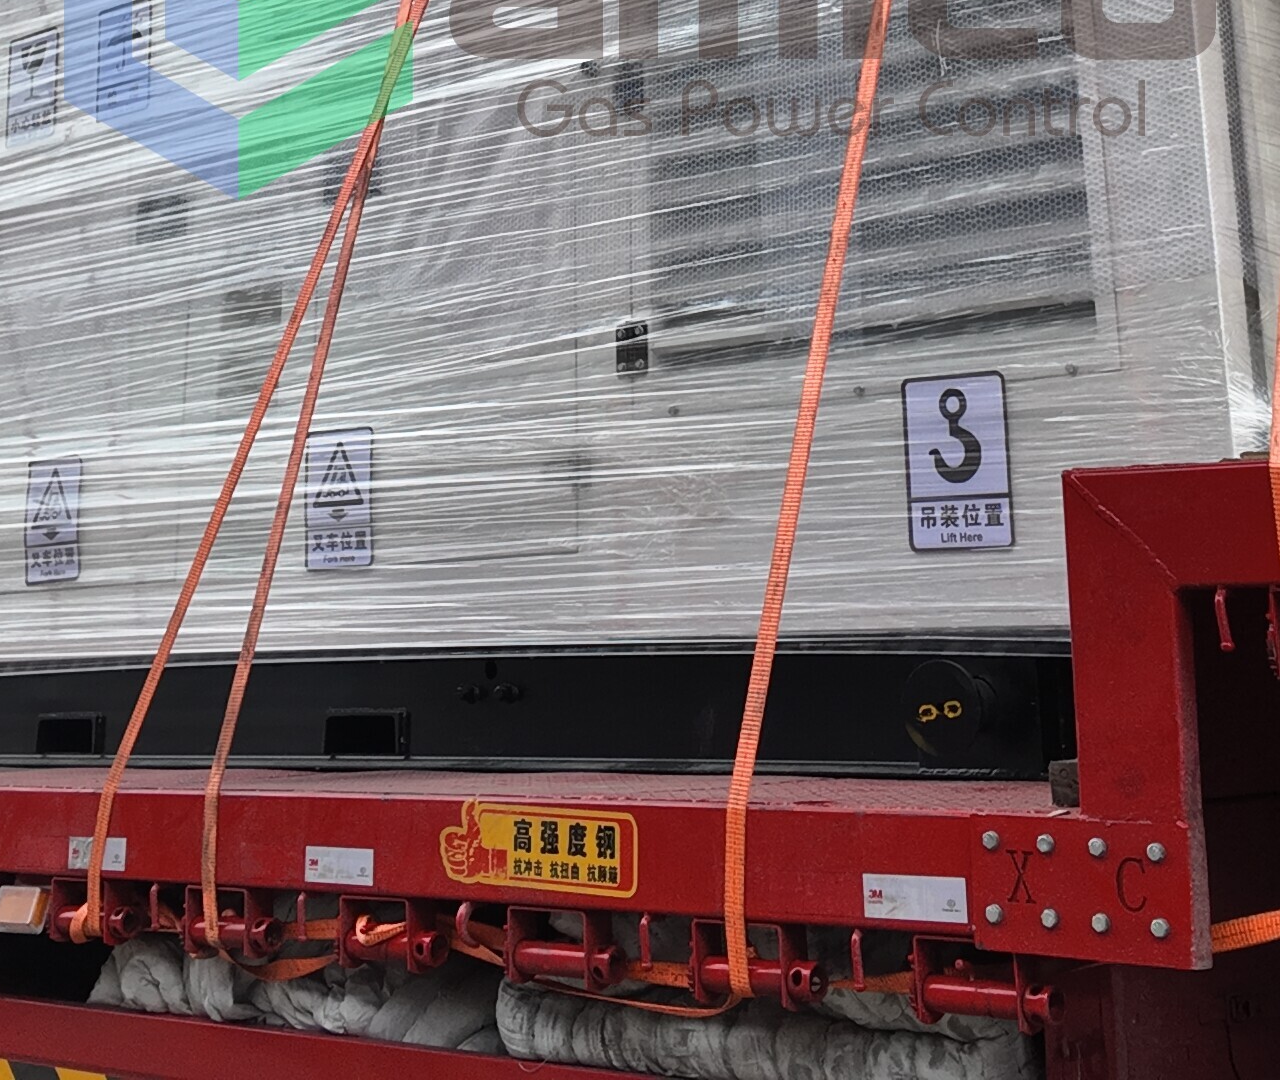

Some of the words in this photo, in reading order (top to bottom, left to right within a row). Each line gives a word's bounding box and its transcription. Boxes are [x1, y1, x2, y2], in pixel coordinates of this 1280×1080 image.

[920, 502, 1005, 529] 吊装位置
[940, 532, 958, 543] Lift
[959, 531, 983, 542] Here
[513, 818, 616, 859] 高强度钢
[513, 857, 543, 877] 抗冲击
